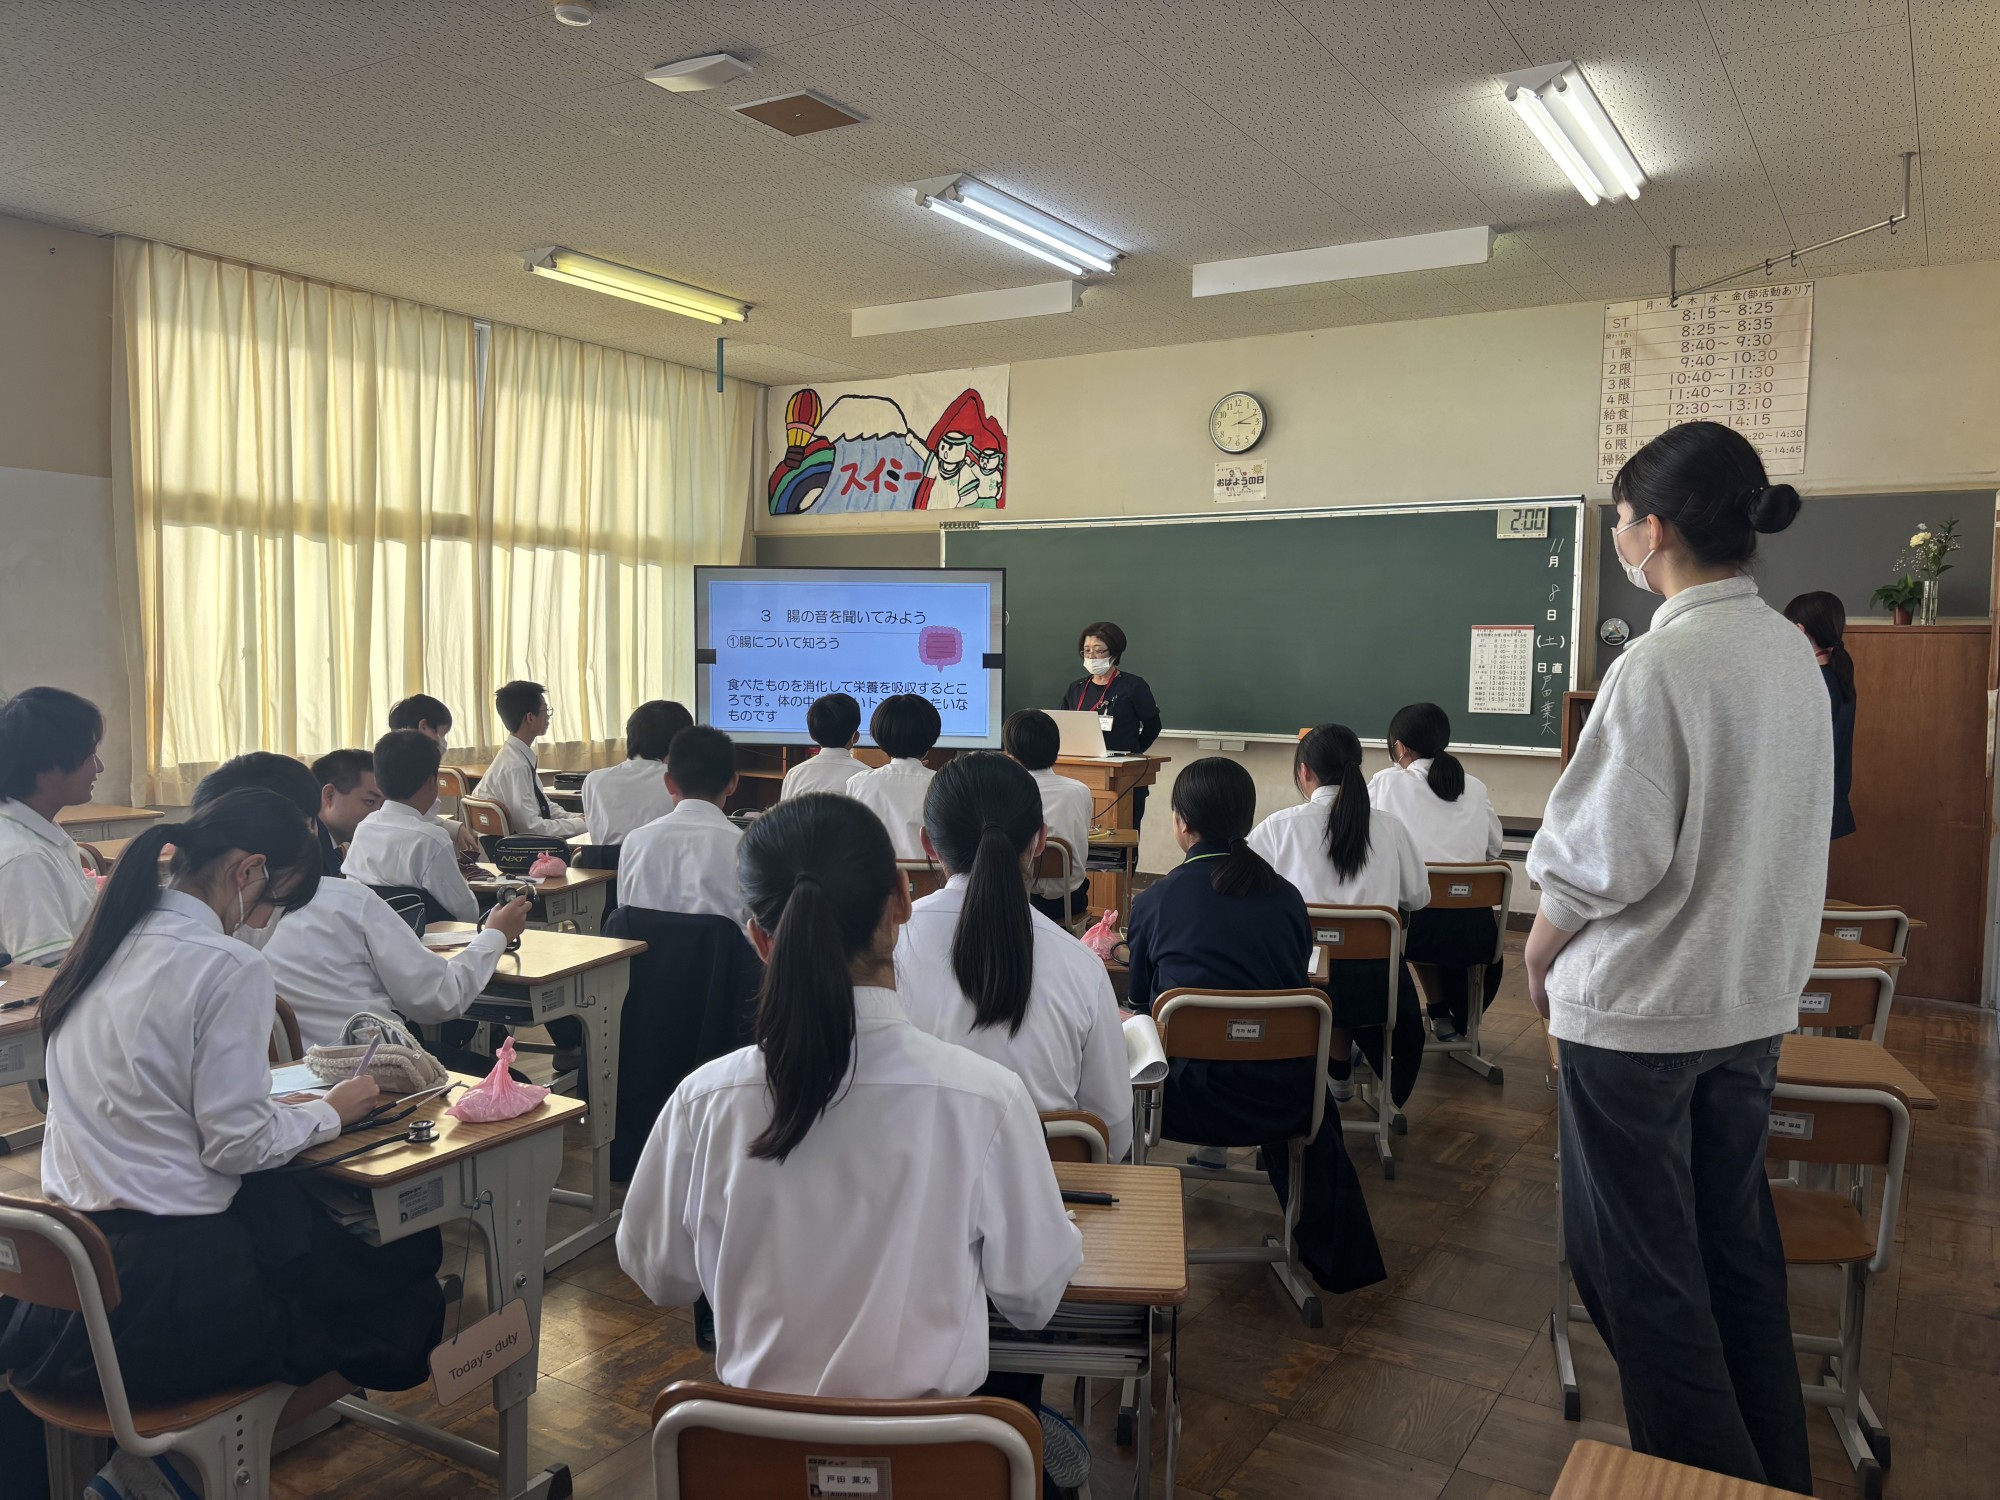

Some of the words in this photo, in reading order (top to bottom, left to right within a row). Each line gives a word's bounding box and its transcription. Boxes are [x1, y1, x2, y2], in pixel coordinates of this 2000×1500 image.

[1613, 317, 1630, 328] ST
[1608, 363, 1631, 374] 2限
[1608, 378, 1631, 389] 3限
[1606, 393, 1630, 404] 4限
[1603, 408, 1629, 420] 給食
[1605, 423, 1628, 435] 5限
[1604, 438, 1627, 450] 6限
[1602, 453, 1627, 466] 掃除
[840, 457, 922, 496] スイミー
[1216, 476, 1264, 487] おはようの日
[1510, 509, 1546, 530] 2:00
[761, 610, 771, 622] 3
[787, 610, 927, 625] 腸の音を聞いてみよう
[727, 636, 840, 650] ①腸について知ろう
[727, 678, 968, 695] 食べたものを消化して栄養を吸収するとこ
[728, 710, 777, 722] ものです
[449, 1350, 492, 1380] Today's
[495, 1332, 518, 1352] duty
